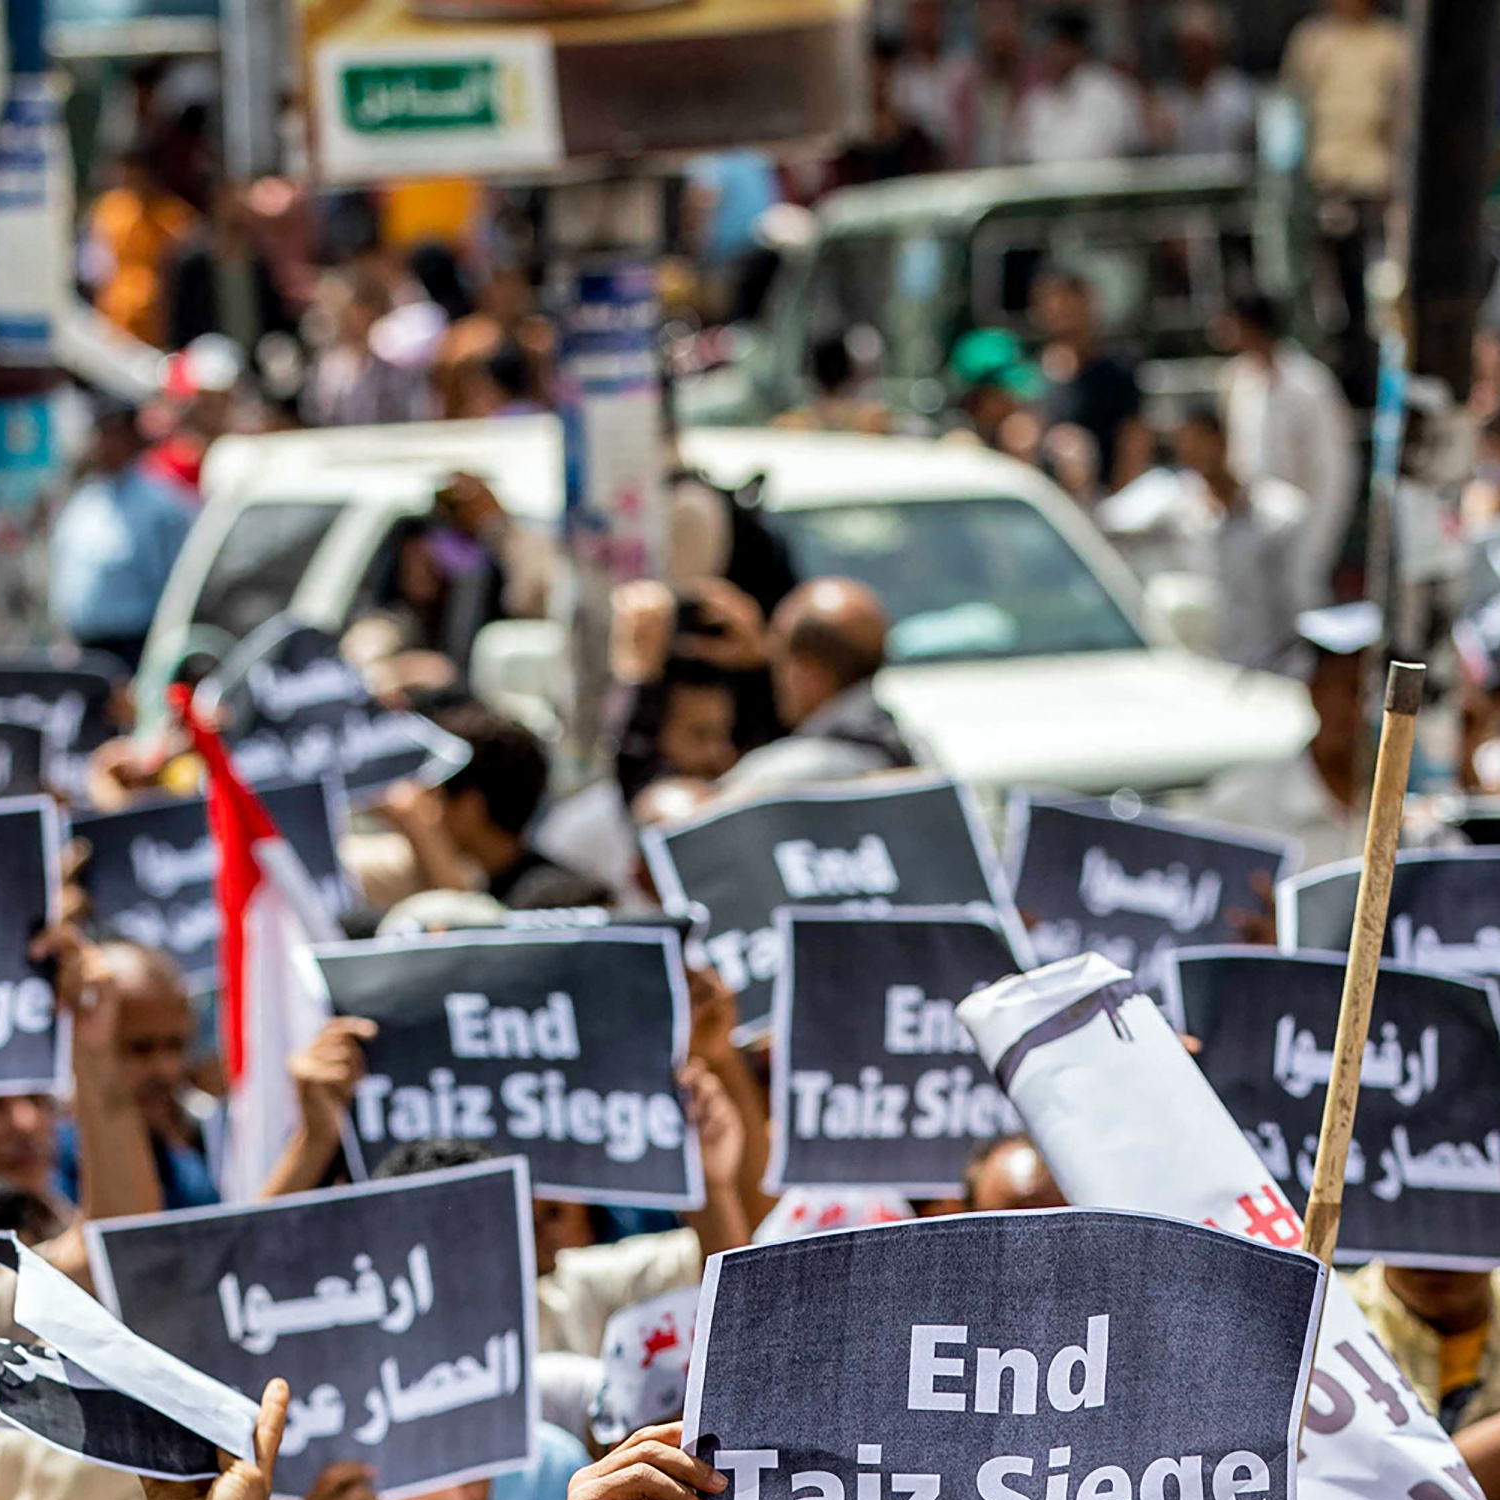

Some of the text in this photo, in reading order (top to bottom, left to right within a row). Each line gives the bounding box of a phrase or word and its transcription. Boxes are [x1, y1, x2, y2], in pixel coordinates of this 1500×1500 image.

[773, 834, 899, 898] End
[444, 991, 581, 1059] End
[355, 1068, 685, 1162] Taiz Siege
[791, 1066, 909, 1140] Taiz
[218, 1243, 434, 1355] ارفعوا
[353, 1329, 522, 1446] الحصار
[906, 1314, 1110, 1415] End
